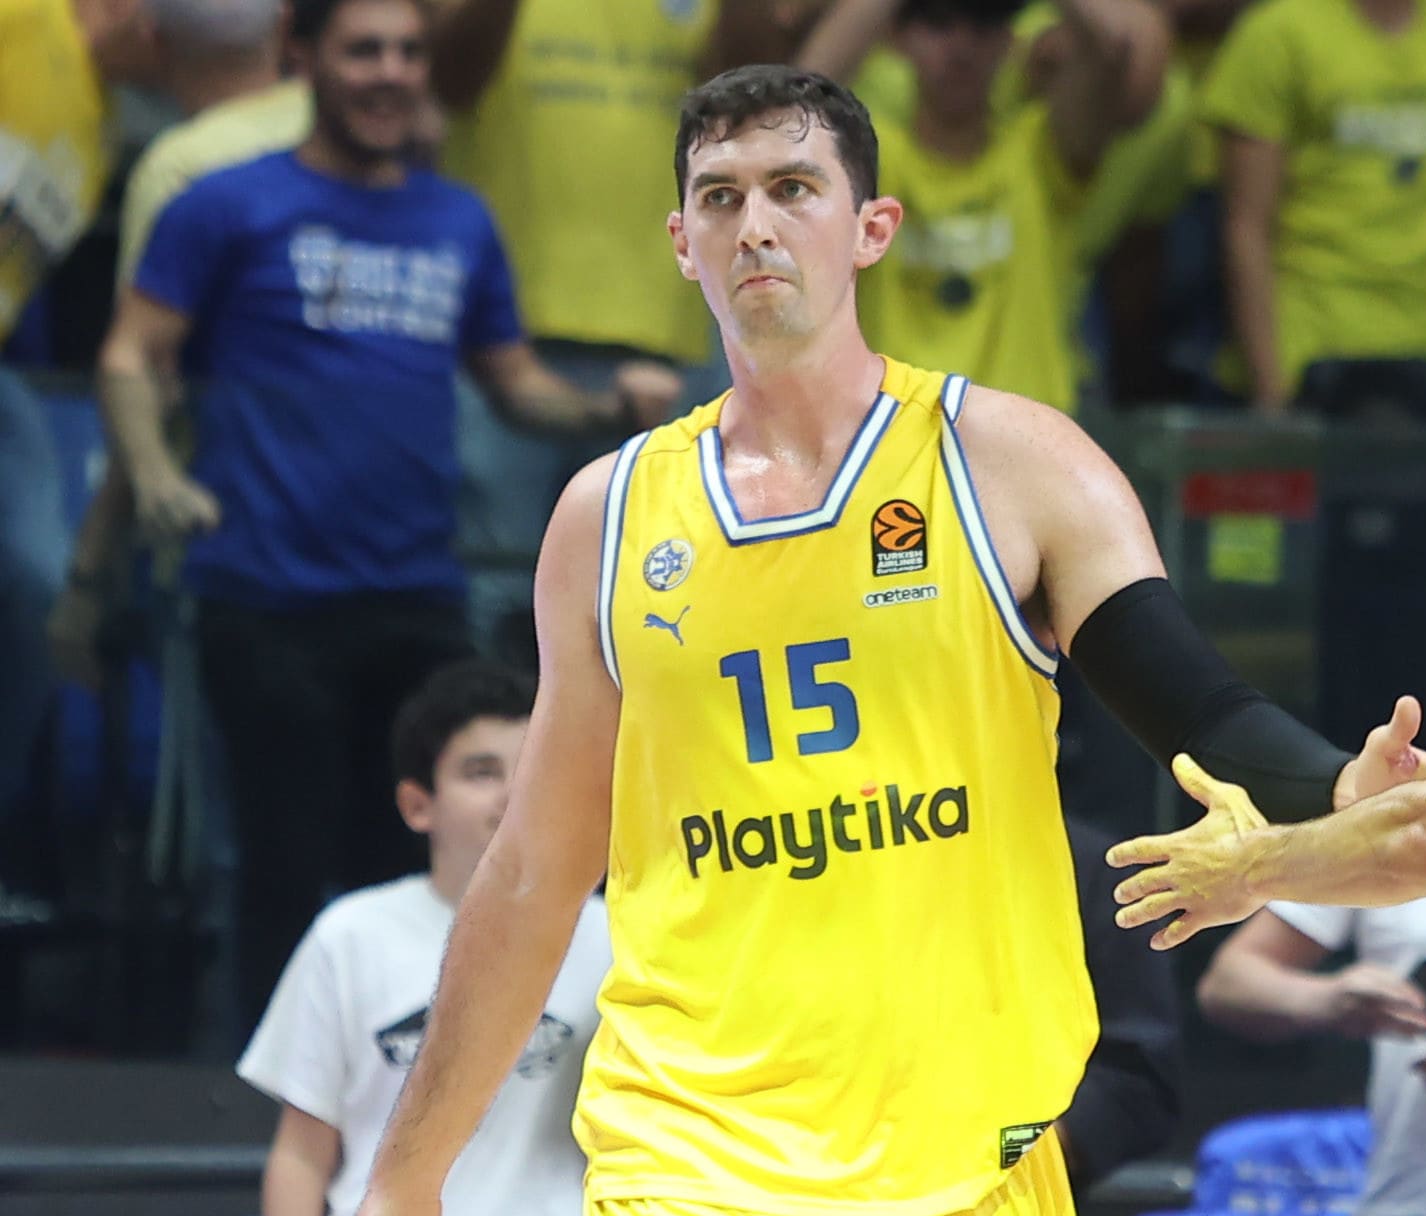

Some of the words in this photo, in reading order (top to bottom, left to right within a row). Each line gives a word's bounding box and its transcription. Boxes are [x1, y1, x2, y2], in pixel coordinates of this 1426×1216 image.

[876, 549, 924, 561] TURKISH
[865, 585, 938, 606] oneteam
[718, 637, 861, 764] 15
[681, 779, 970, 881] Playtika
